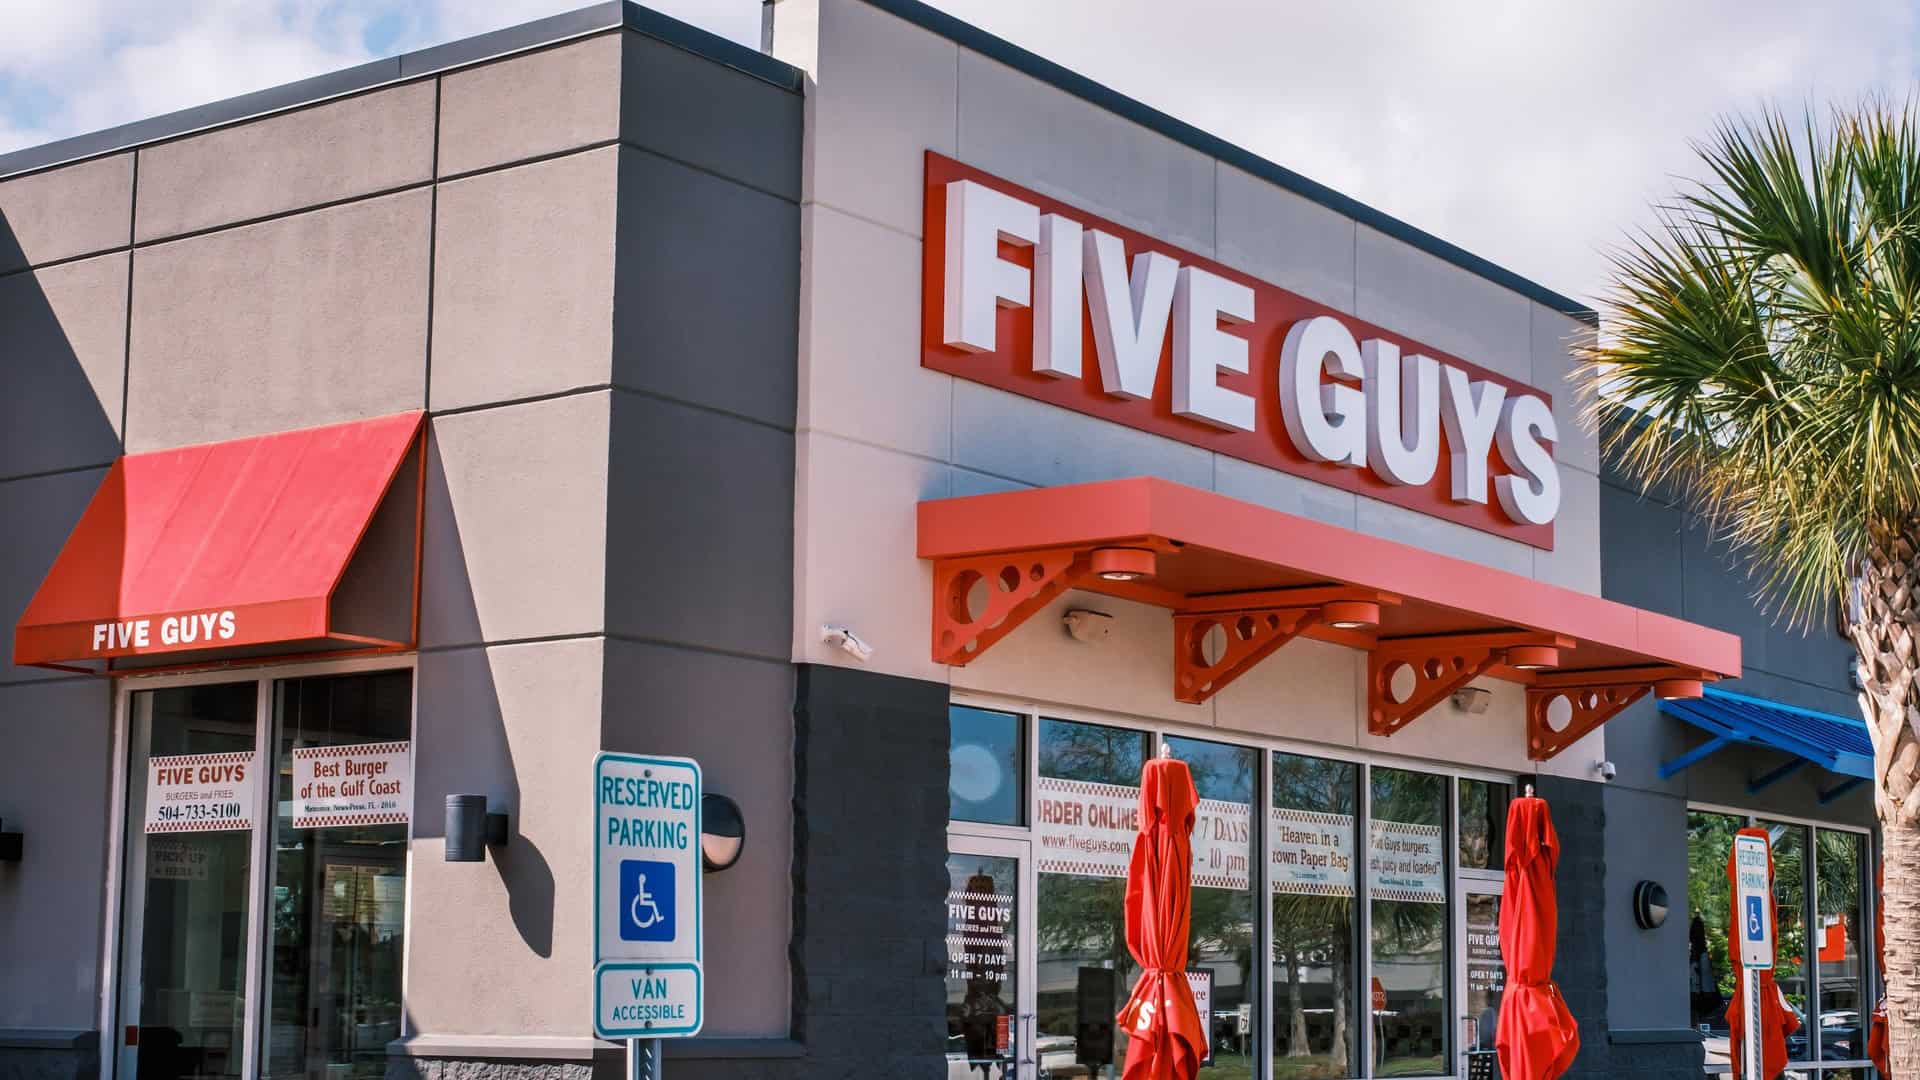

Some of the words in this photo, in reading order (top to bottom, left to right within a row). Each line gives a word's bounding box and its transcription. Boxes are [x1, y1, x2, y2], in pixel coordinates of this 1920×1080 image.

[943, 178, 1256, 433] FIVE
[1279, 315, 1561, 527] GUYS
[92, 620, 150, 651] FIVE
[161, 610, 236, 646] GUYS
[157, 767, 194, 785] FIVE
[199, 764, 245, 783] GUYS
[314, 761, 340, 778] Best
[345, 759, 388, 779] Burger
[301, 782, 313, 799] of
[317, 781, 336, 798] the
[341, 780, 365, 797] Gulf
[369, 779, 400, 795] Coast
[602, 776, 693, 811] RESERVED
[158, 802, 241, 821] 504-733-5100
[608, 817, 688, 850] PARKING
[1201, 815, 1209, 837] 7
[1041, 833, 1129, 856] www.fiveguys.com
[1321, 829, 1331, 847] in
[1333, 834, 1339, 847] a
[1385, 836, 1401, 854] Guys
[1209, 847, 1222, 871] 10
[1226, 854, 1246, 876] pm
[1272, 850, 1297, 865] rown
[1301, 848, 1327, 870] Paper
[1399, 859, 1412, 873] and
[948, 904, 976, 920] FIVE
[978, 906, 1011, 922] GUYS
[1468, 934, 1484, 945] FIVE
[1486, 935, 1500, 946] GUY
[951, 952, 976, 964] OPEN
[977, 953, 983, 964] 7
[984, 953, 1007, 966] DAYS
[951, 968, 959, 979] 11
[961, 970, 973, 980] am
[985, 969, 994, 980] 10
[995, 972, 1008, 982] pm
[631, 978, 667, 999] VAN
[613, 1004, 685, 1021] ACCESSIBLE
